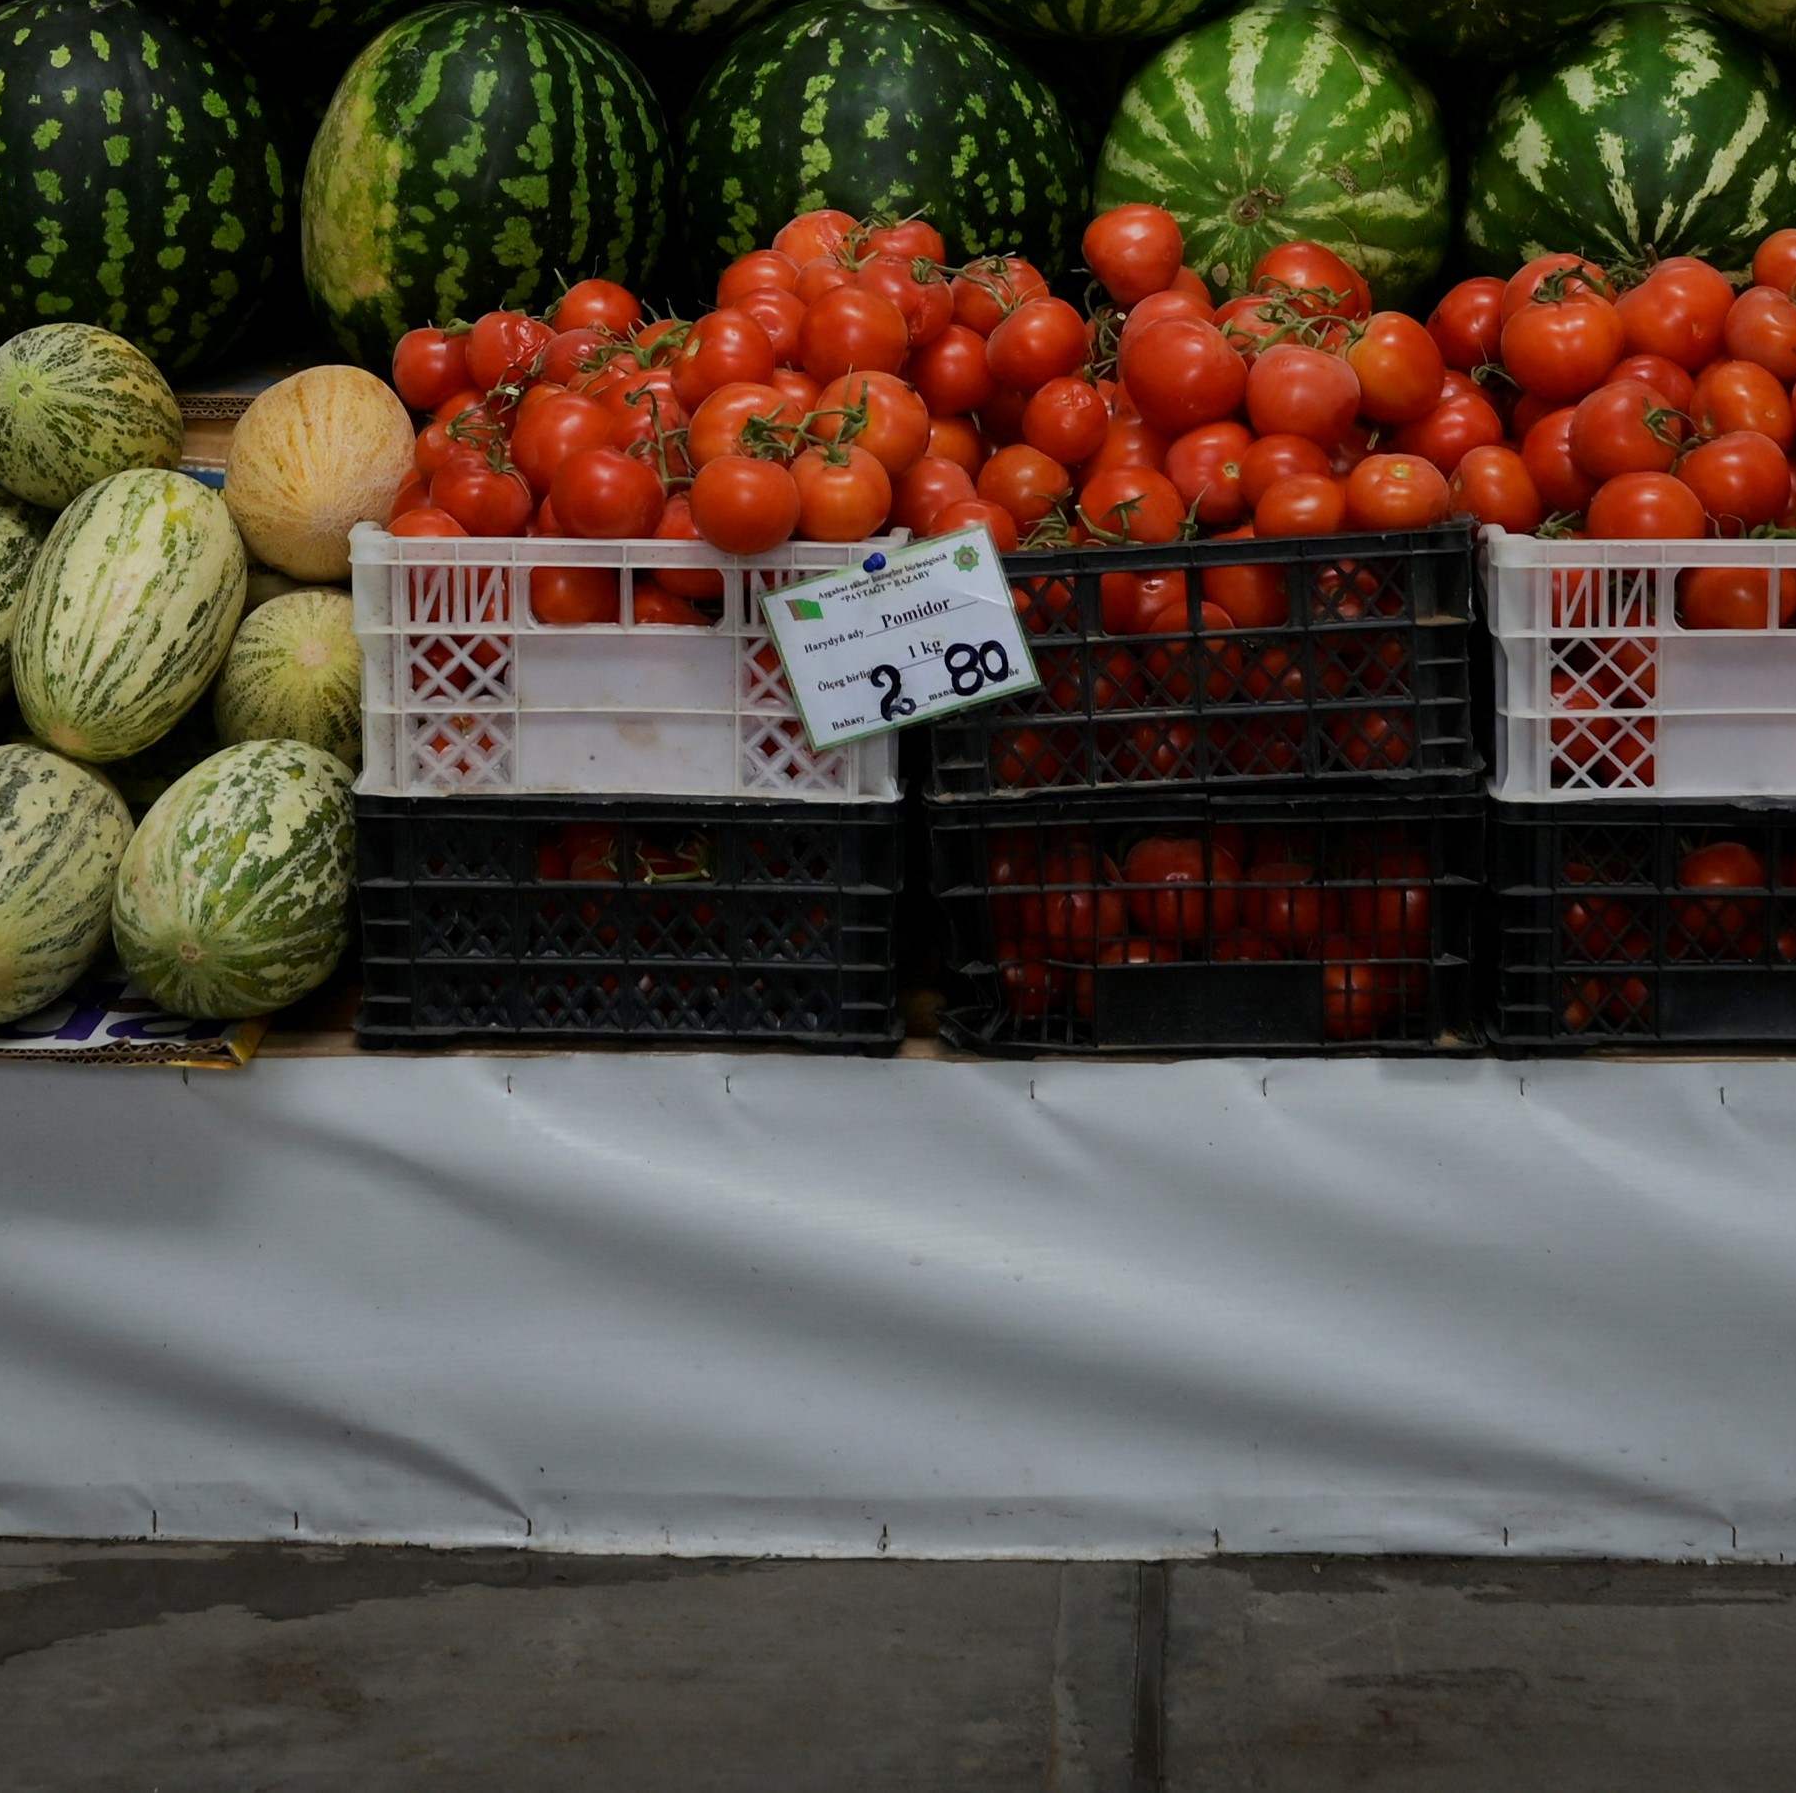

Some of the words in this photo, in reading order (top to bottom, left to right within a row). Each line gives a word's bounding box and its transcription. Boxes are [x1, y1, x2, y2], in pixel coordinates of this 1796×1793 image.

[894, 569, 930, 588] BAZARY
[804, 635, 846, 654] Harydyň
[847, 628, 865, 644] ady
[881, 597, 951, 629] Pomidor
[818, 676, 846, 692] Ölçeg
[908, 645, 916, 659] 1
[921, 638, 944, 655] kg
[831, 714, 866, 732] Bahasy
[870, 664, 917, 722] 2
[944, 640, 1009, 697] 80
